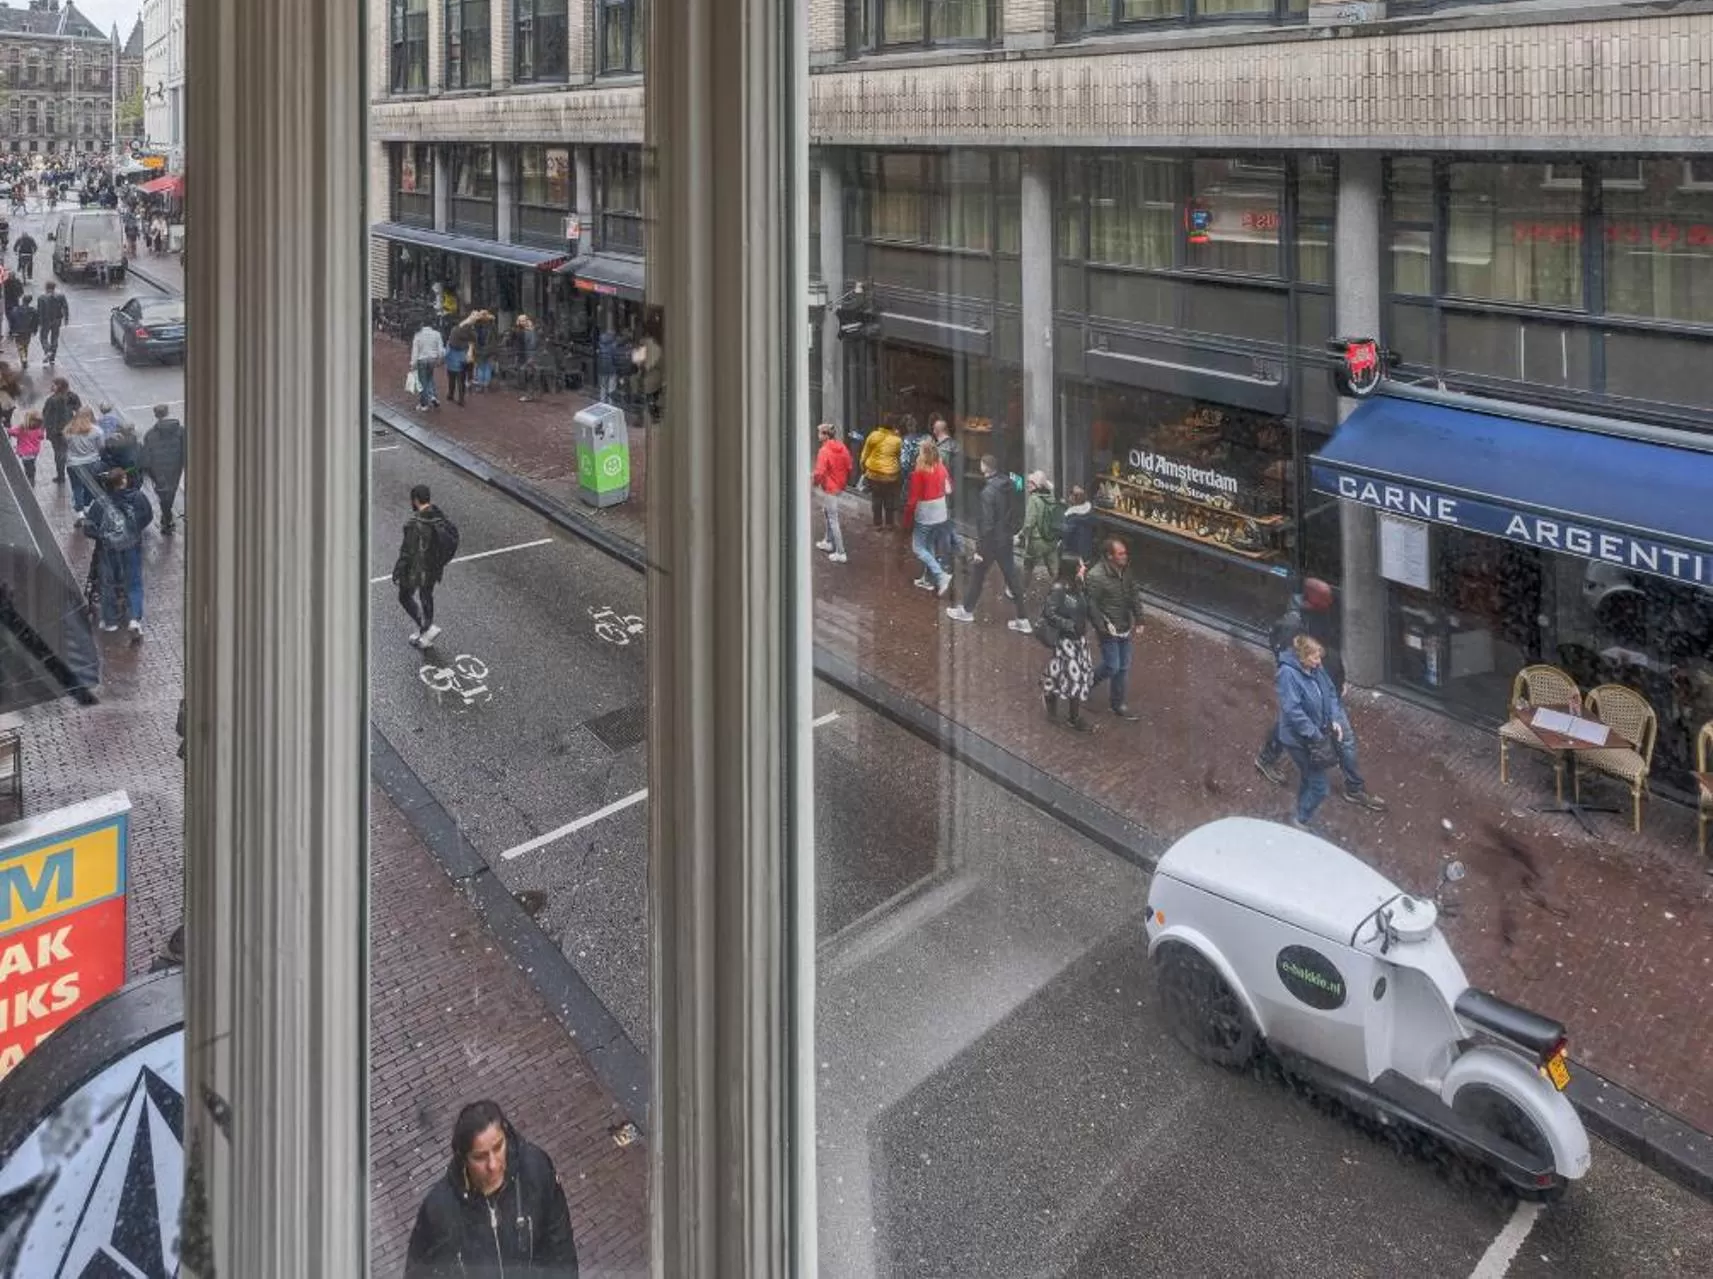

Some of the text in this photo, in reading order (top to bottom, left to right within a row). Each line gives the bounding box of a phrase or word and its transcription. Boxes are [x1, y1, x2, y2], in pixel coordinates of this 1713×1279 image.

[1129, 449, 1238, 493] Old Amsterdam
[1339, 475, 1702, 581] CARNE ARGENTI
